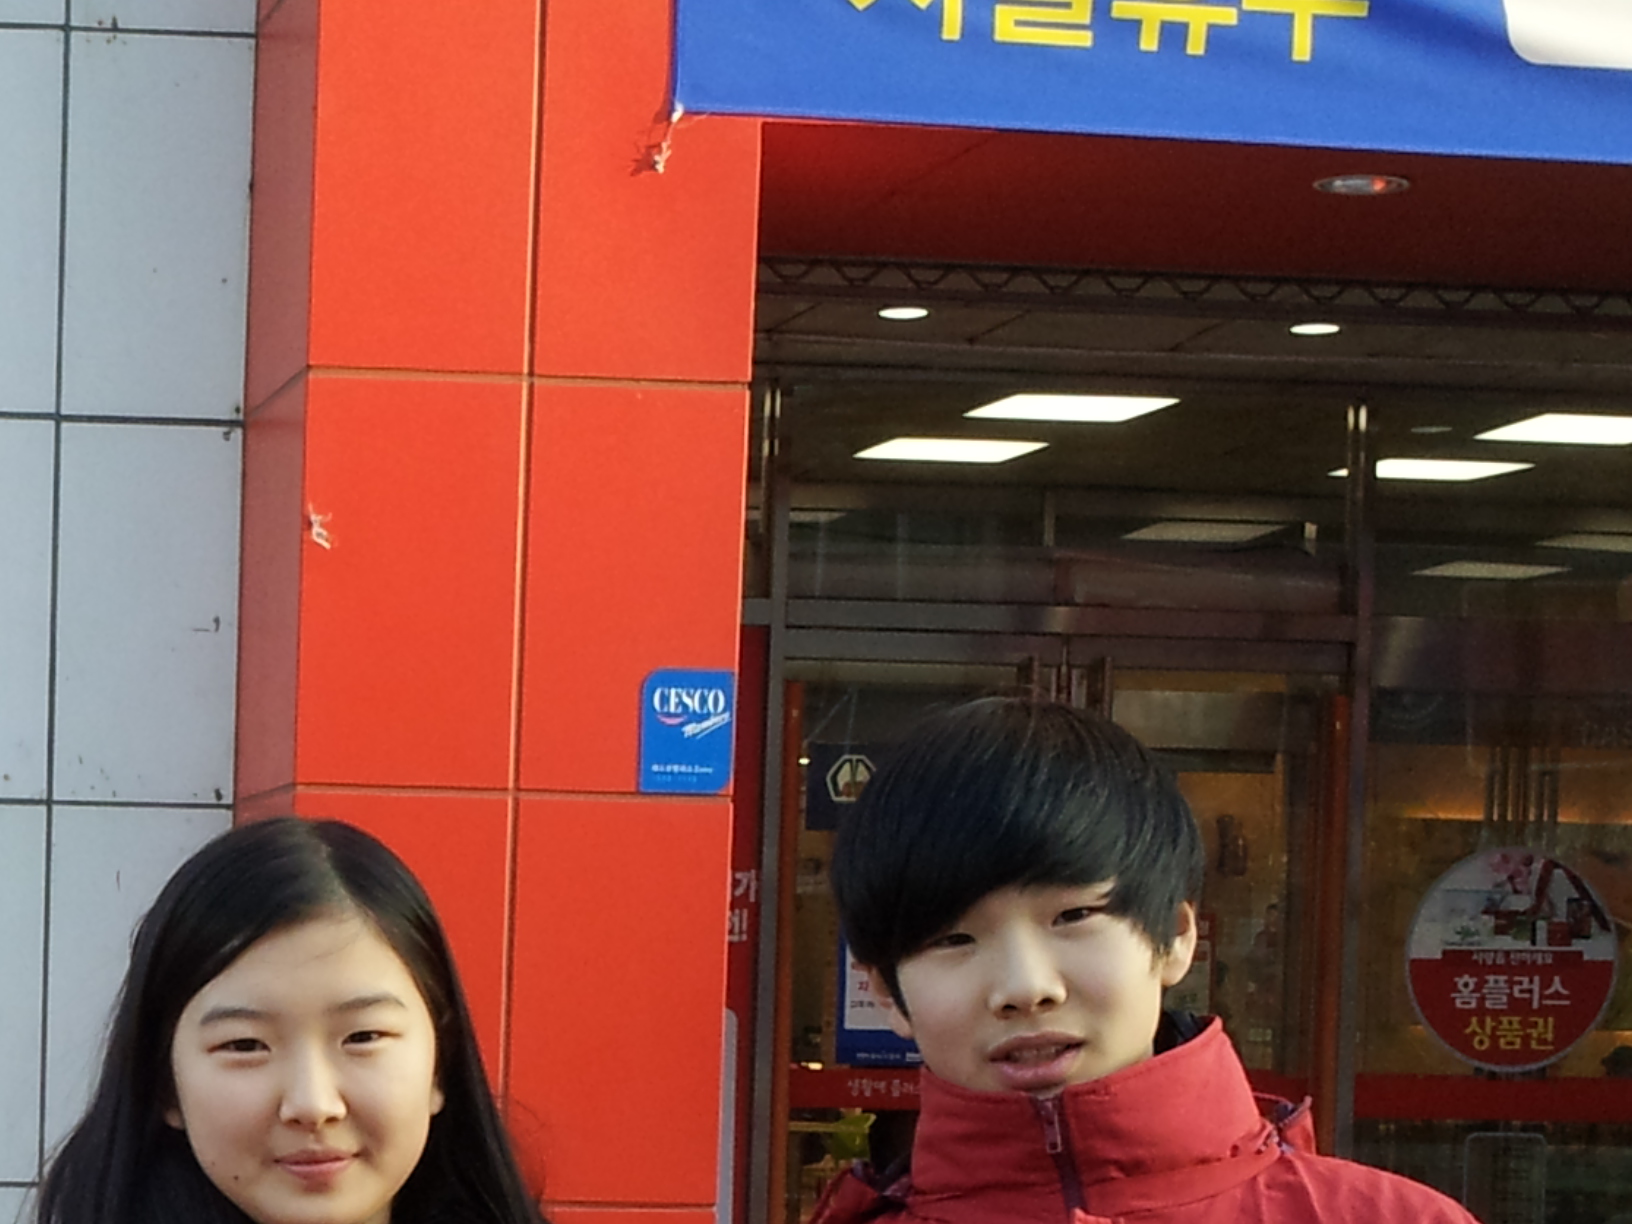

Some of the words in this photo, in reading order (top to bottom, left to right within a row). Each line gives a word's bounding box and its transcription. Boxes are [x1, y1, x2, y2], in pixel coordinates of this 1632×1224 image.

[653, 687, 725, 714] CESCO
[1450, 974, 1571, 1010] 홈플러스
[1464, 1015, 1556, 1051] 상품권
